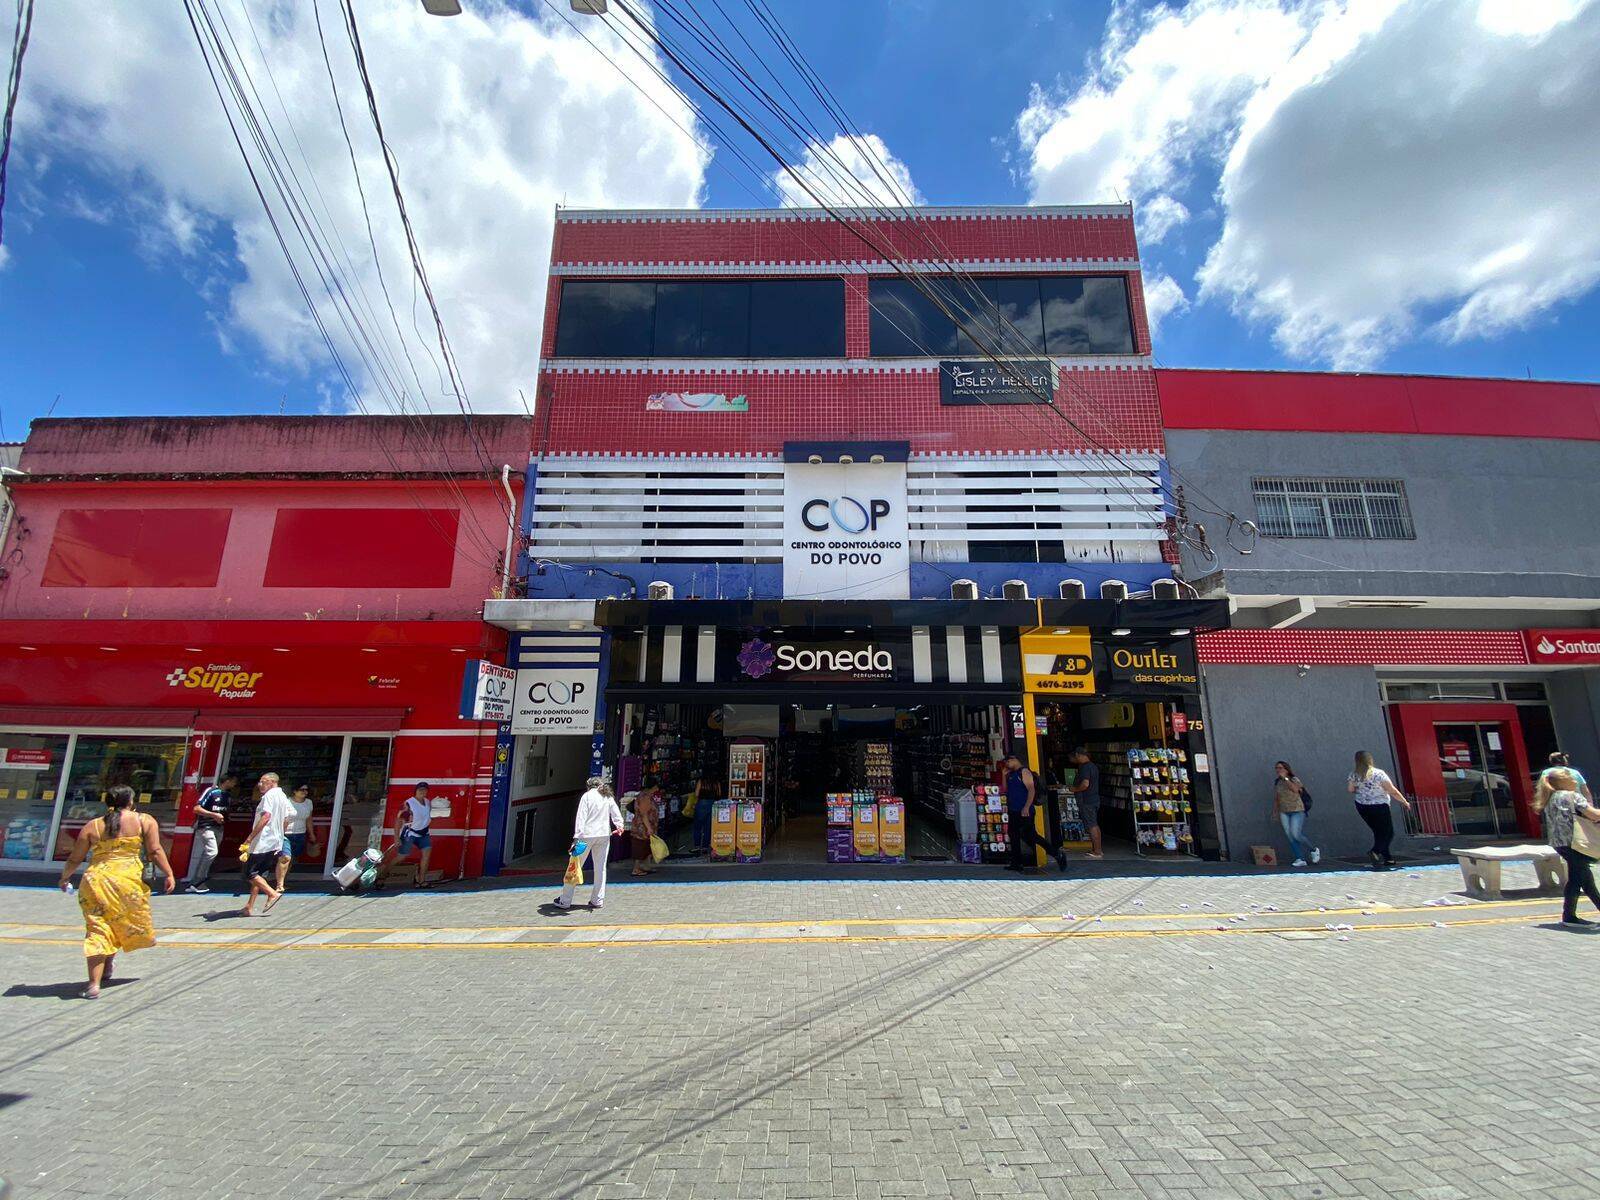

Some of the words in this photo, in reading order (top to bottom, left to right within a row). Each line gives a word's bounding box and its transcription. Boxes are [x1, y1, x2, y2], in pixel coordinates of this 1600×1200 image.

[801, 496, 891, 534] COP
[828, 540, 902, 549] ODONTOLÓGICO
[810, 553, 833, 565] DO
[838, 553, 882, 565] POVO
[776, 645, 893, 671] Soneda
[481, 664, 515, 680] DENTISTAS
[184, 666, 263, 693] Super
[1135, 674, 1153, 682] das
[1154, 674, 1197, 684] capinhas
[486, 678, 506, 697] COP
[1036, 681, 1085, 689] 4676-2195
[219, 689, 256, 699] Popular
[528, 680, 585, 705] COP
[533, 717, 547, 725] DO
[548, 716, 573, 724] POVO
[1010, 712, 1024, 721] 71
[1187, 720, 1203, 730] 75
